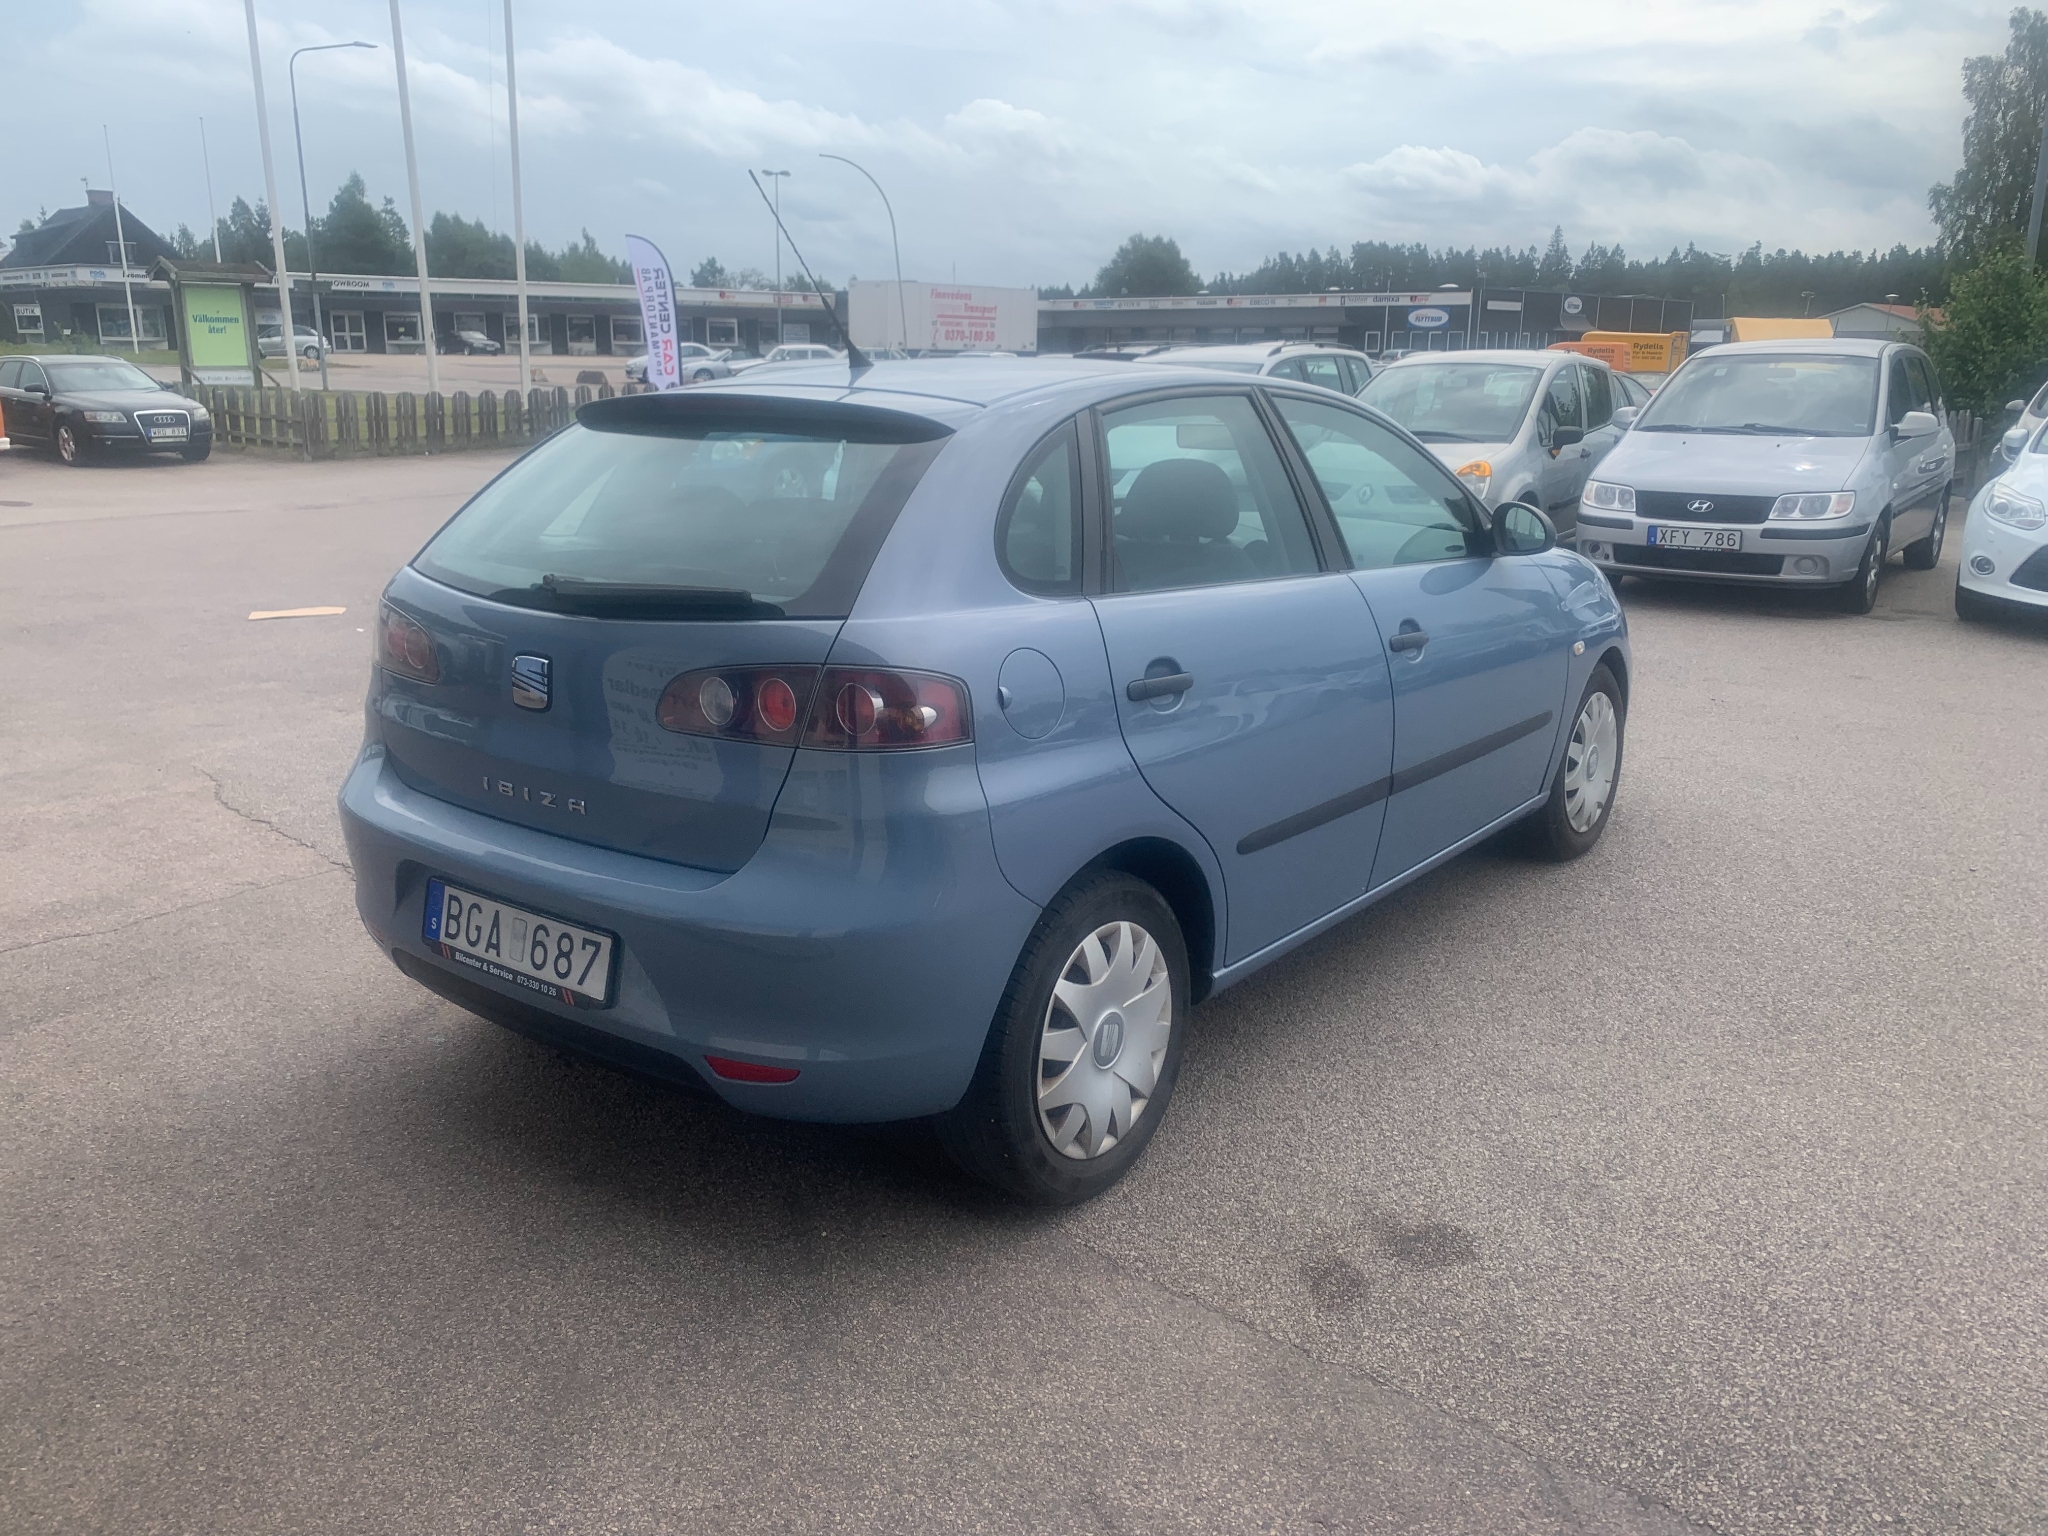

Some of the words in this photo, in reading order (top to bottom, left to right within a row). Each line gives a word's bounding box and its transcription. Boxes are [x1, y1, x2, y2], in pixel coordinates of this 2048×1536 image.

[931, 288, 972, 300] Finnvedens
[964, 303, 997, 316] Transport
[192, 314, 239, 324] Välkommen
[208, 325, 227, 334] åter!
[1587, 347, 1615, 355] Rydells
[1633, 342, 1664, 351] Rydells
[1659, 529, 1690, 544] XFY
[1703, 531, 1737, 547] 786
[482, 776, 586, 815] IBIZA
[444, 893, 501, 957] BGA
[530, 923, 602, 986] 687
[455, 951, 482, 971] Bilcenter
[482, 962, 488, 972] &
[489, 964, 514, 981] Service
[516, 975, 540, 991] 073-330
[540, 983, 548, 995] 10
[549, 985, 557, 997] 26
